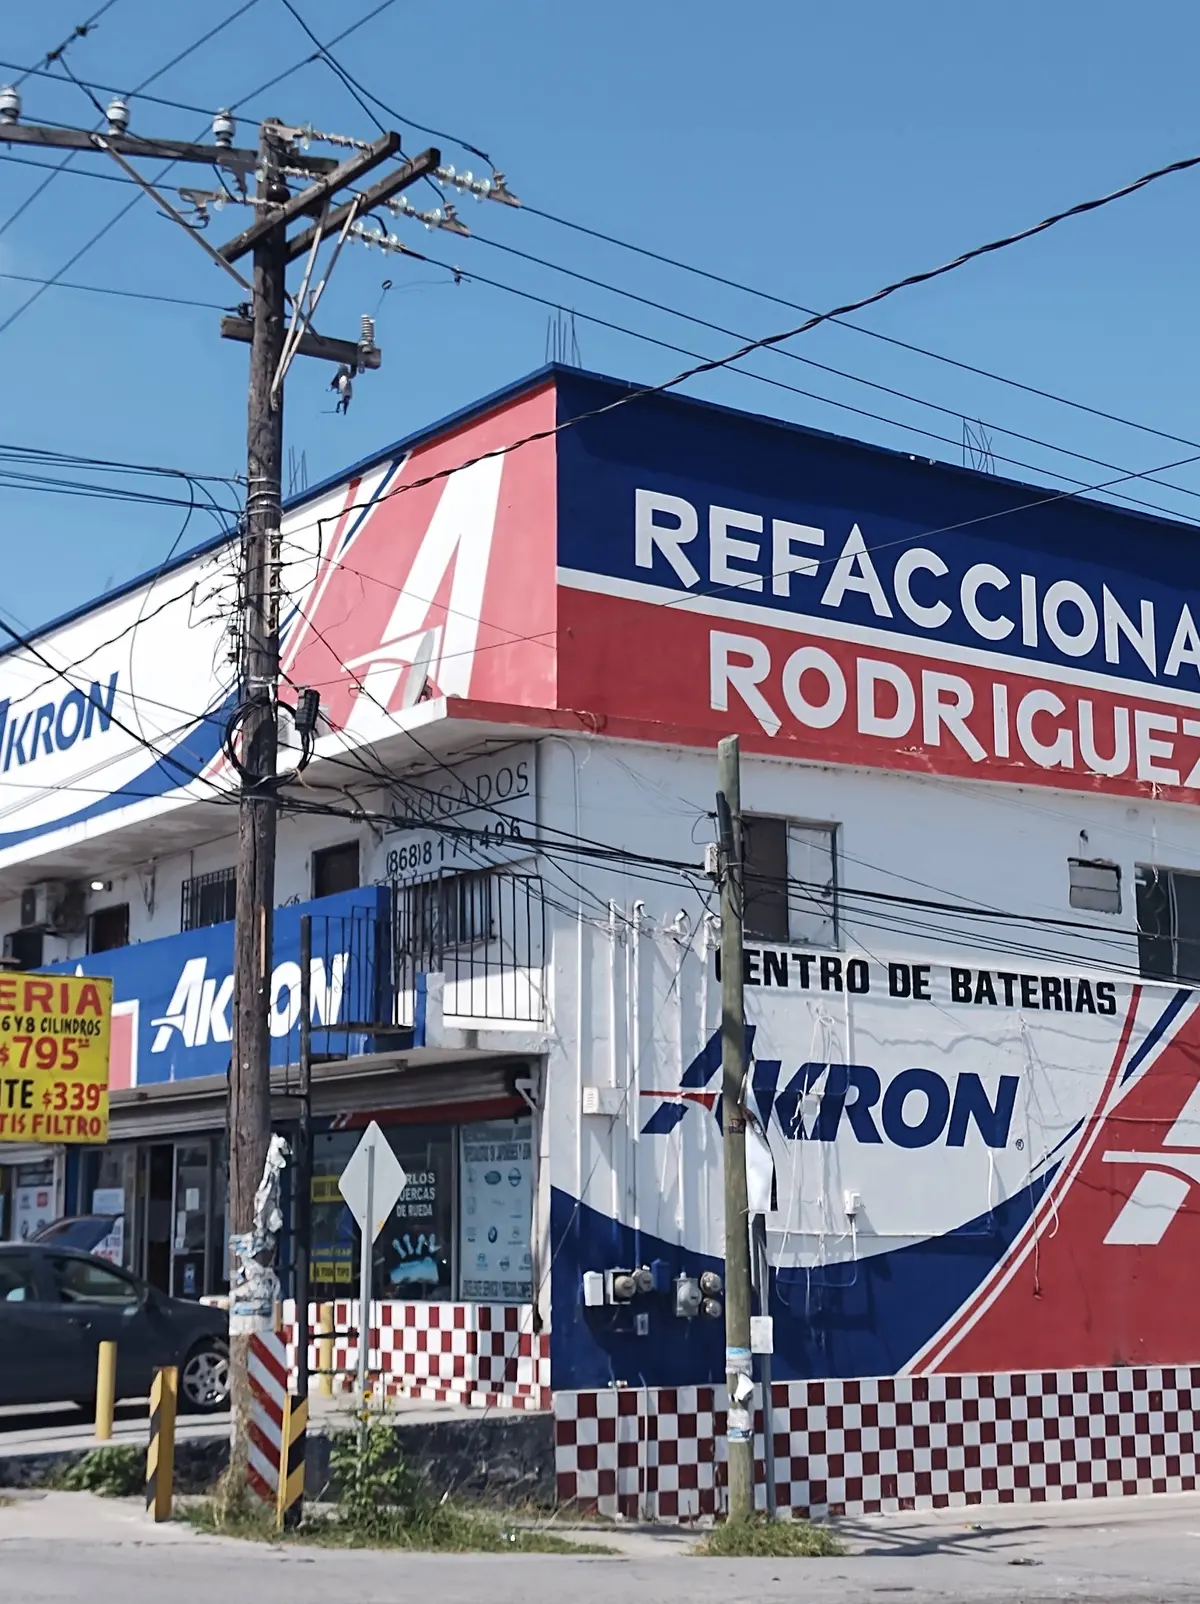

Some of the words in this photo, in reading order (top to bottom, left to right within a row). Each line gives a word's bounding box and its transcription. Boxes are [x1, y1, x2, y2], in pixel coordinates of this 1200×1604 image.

[0, 671, 119, 773] KRON
[715, 950, 870, 994] ENTRO
[888, 962, 932, 1000] DE
[951, 967, 1117, 1016] BATERIAS
[150, 951, 349, 1054] AKON
[1, 1015, 11, 1031] 6
[40, 1017, 101, 1037] CILINDROS
[0, 1078, 34, 1109] TE
[32, 1114, 102, 1136] FILTRO
[399, 1186, 436, 1202] UERCAS
